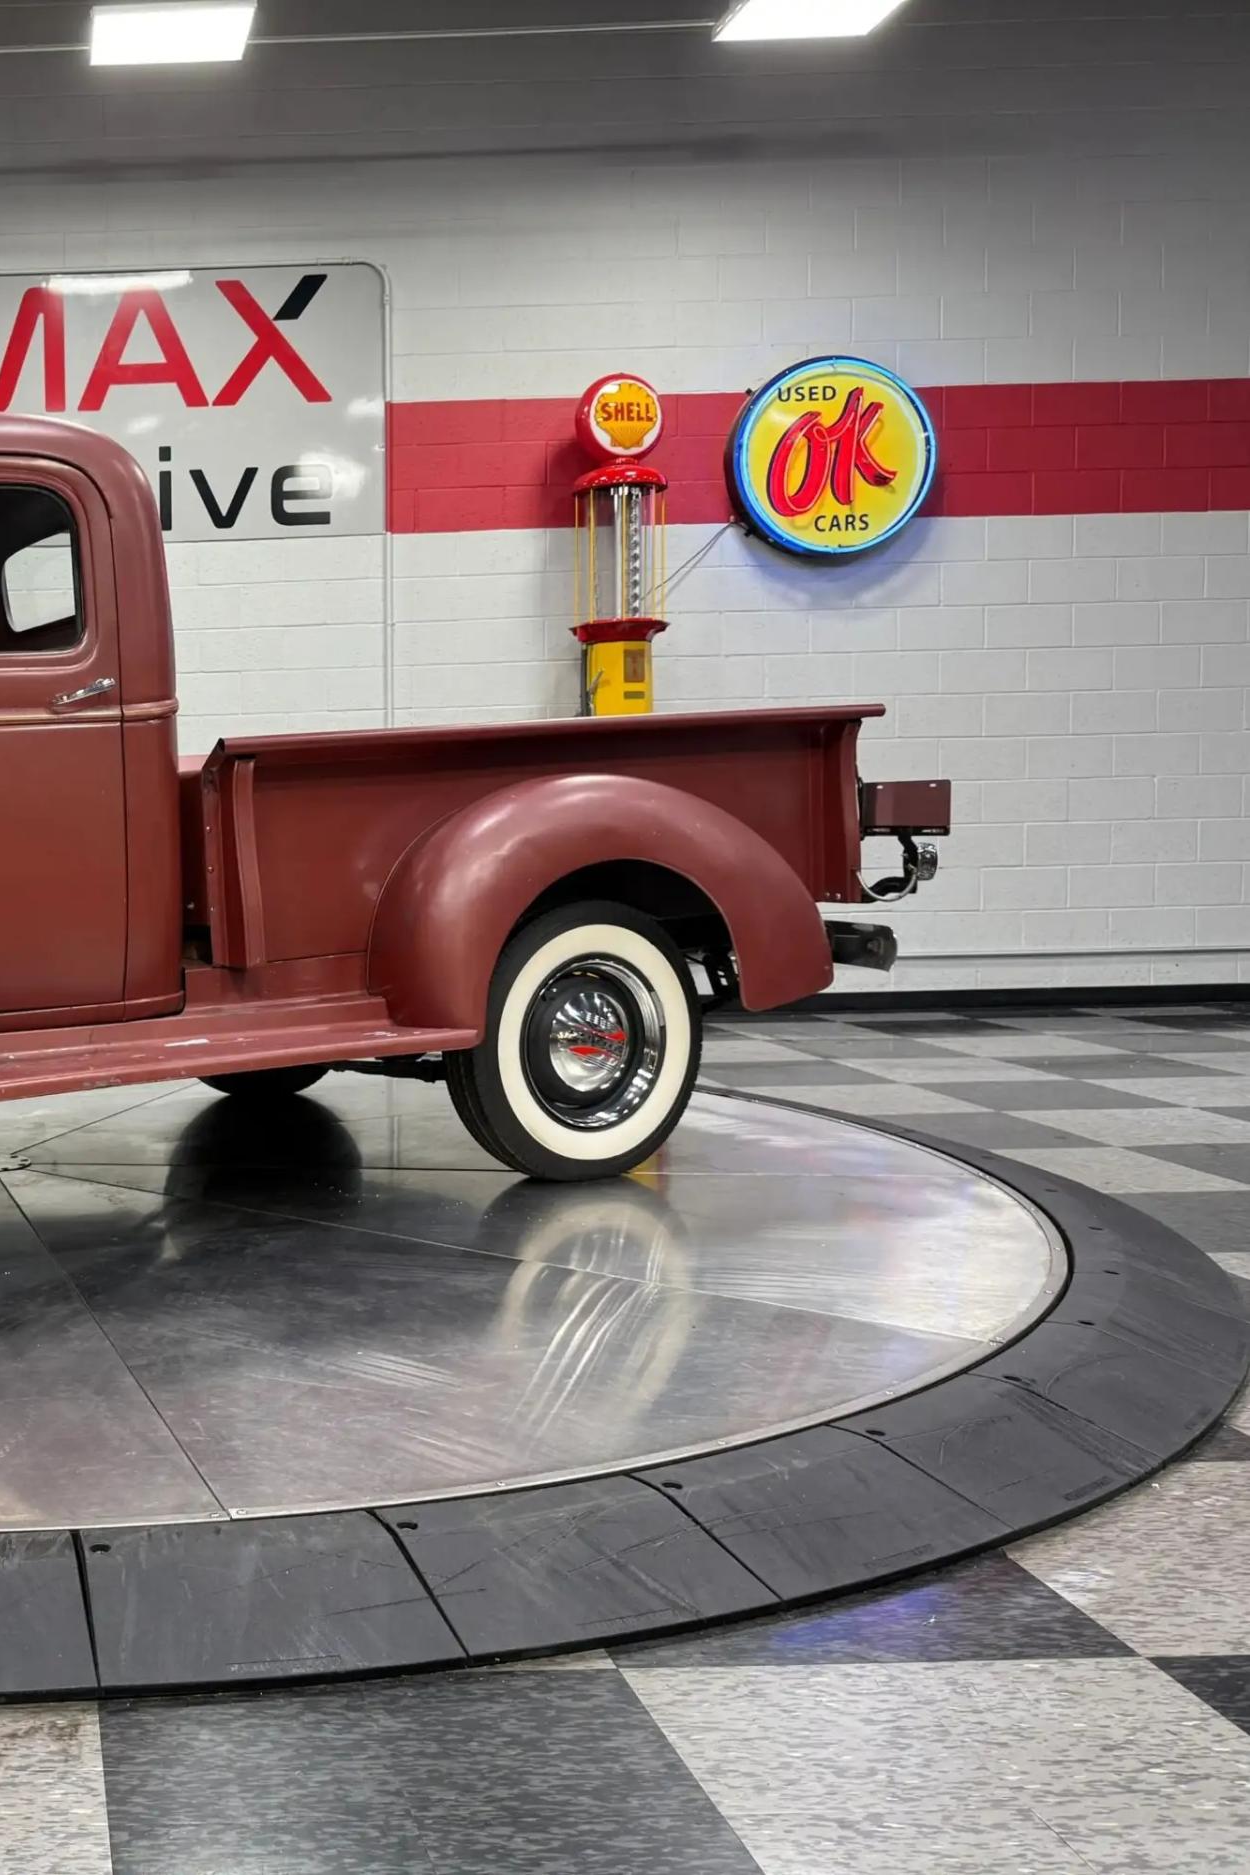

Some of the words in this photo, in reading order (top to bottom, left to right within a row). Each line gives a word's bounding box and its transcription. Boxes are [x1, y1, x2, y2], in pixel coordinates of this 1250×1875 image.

[777, 385, 837, 402] USED
[600, 401, 654, 422] SHELL
[766, 387, 898, 517] OK
[159, 445, 333, 531] ive
[813, 514, 870, 532] CARS
